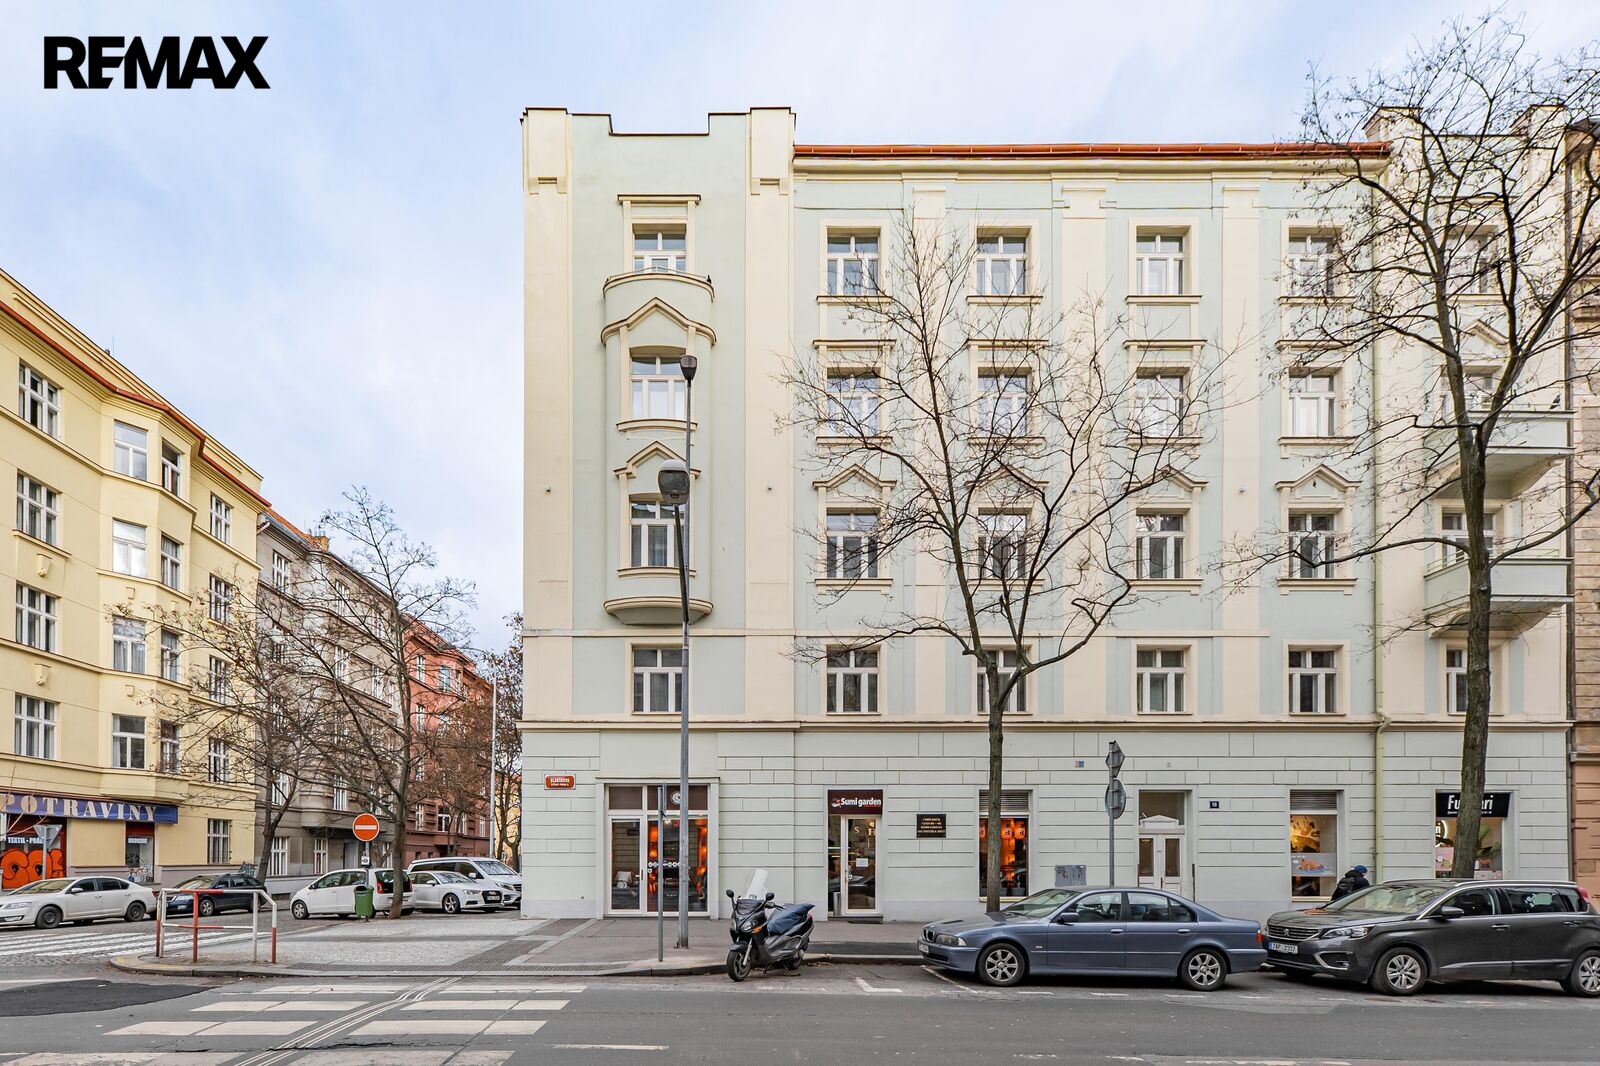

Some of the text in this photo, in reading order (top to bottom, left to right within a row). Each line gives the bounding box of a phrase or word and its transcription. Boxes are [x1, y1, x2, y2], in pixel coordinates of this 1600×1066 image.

[0, 793, 156, 822] POTRAVINY
[840, 797, 881, 808] Sumi garden
